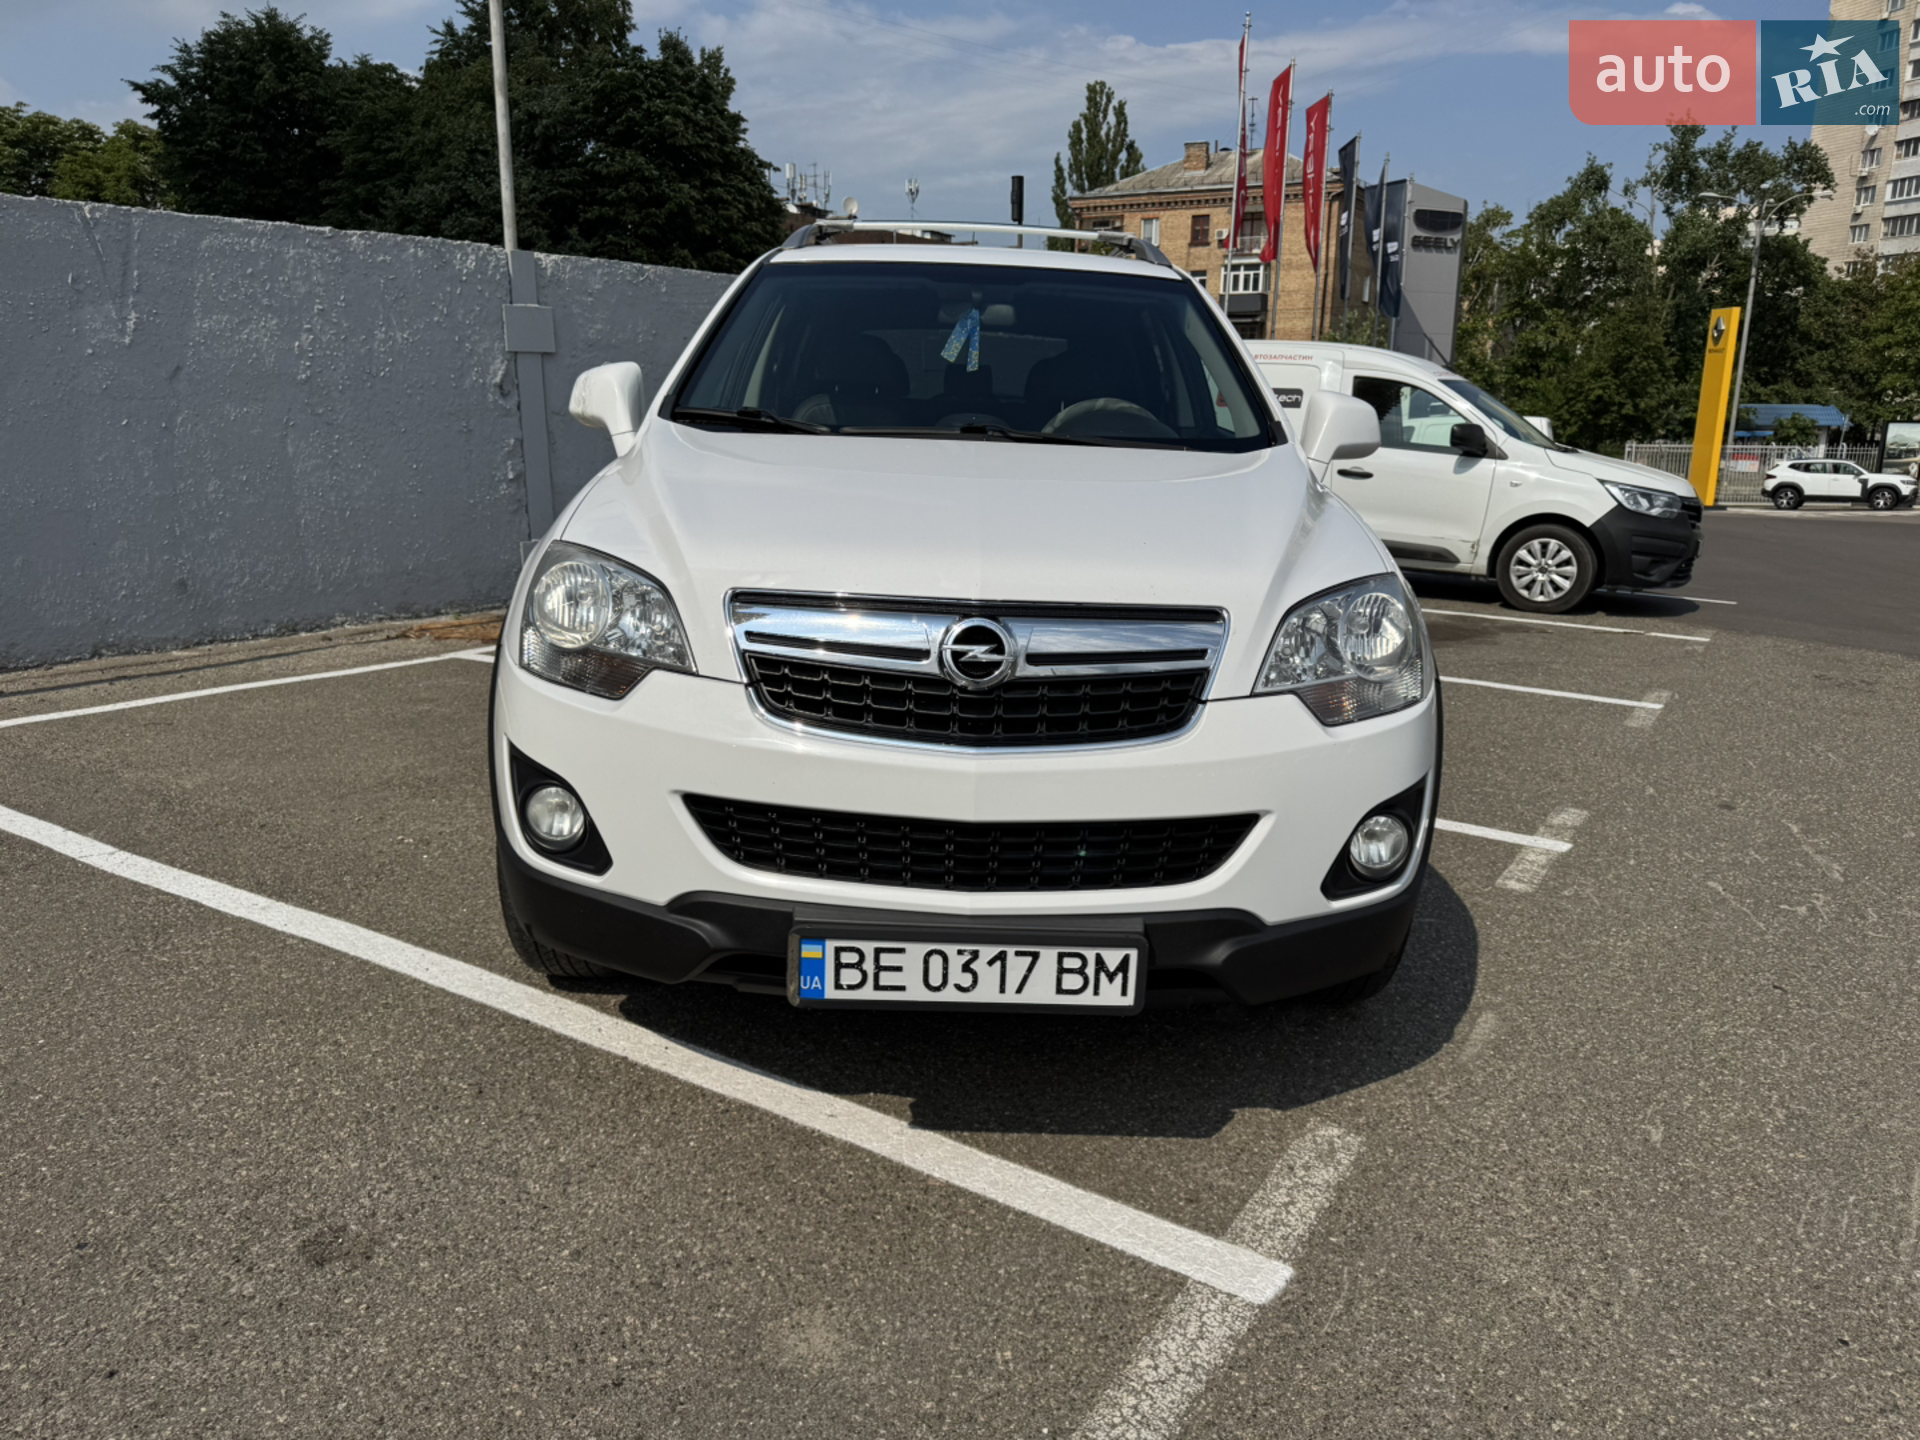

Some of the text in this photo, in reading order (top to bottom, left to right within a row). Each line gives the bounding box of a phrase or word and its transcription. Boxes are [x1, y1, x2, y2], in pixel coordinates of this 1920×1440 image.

[1411, 235, 1461, 250] GEELY
[834, 946, 1131, 997] BE 0317 BM
[801, 975, 822, 990] UA
